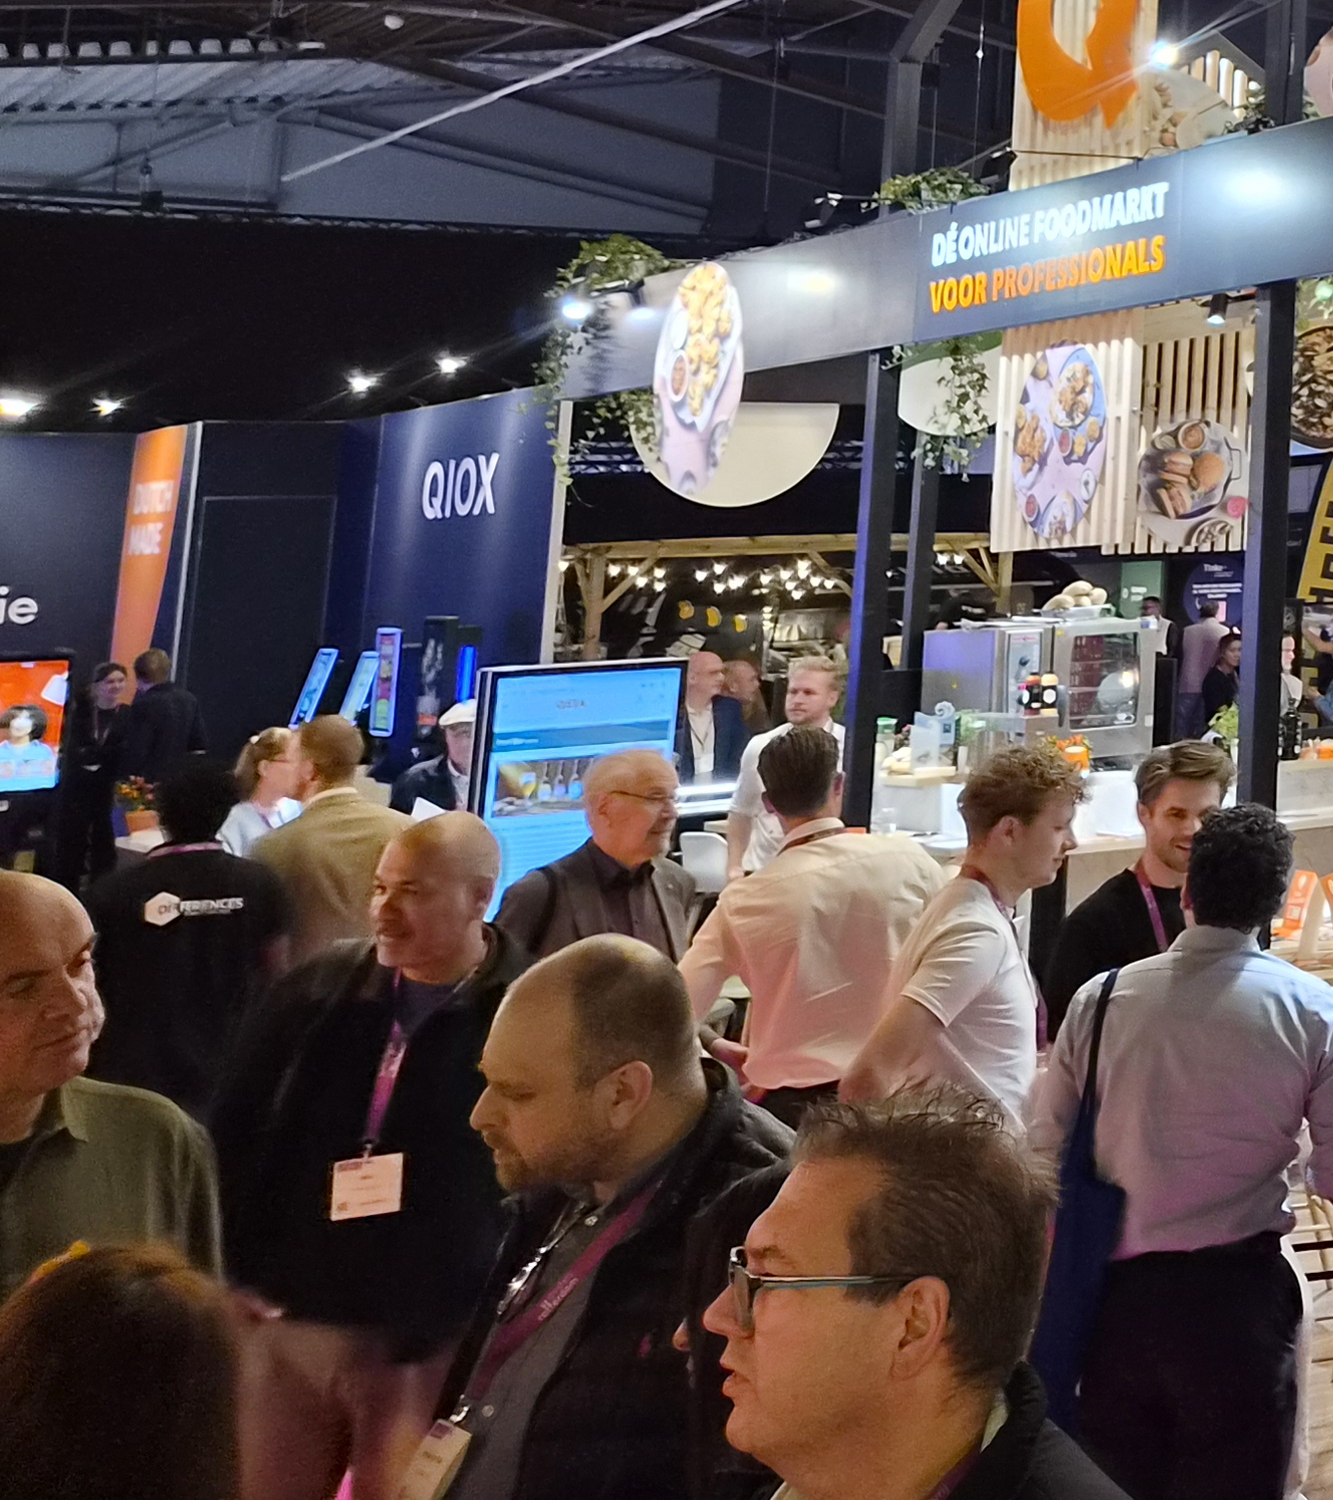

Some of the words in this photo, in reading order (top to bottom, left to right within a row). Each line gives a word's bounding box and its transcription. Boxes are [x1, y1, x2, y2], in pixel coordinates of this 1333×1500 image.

[931, 221, 958, 267] DÉ
[957, 213, 1031, 261] ONLINE
[1033, 181, 1170, 244] FOODMARKT
[929, 271, 988, 313] VOOR
[991, 235, 1167, 301] PROFESSIONALS
[422, 452, 500, 520] QIOX
